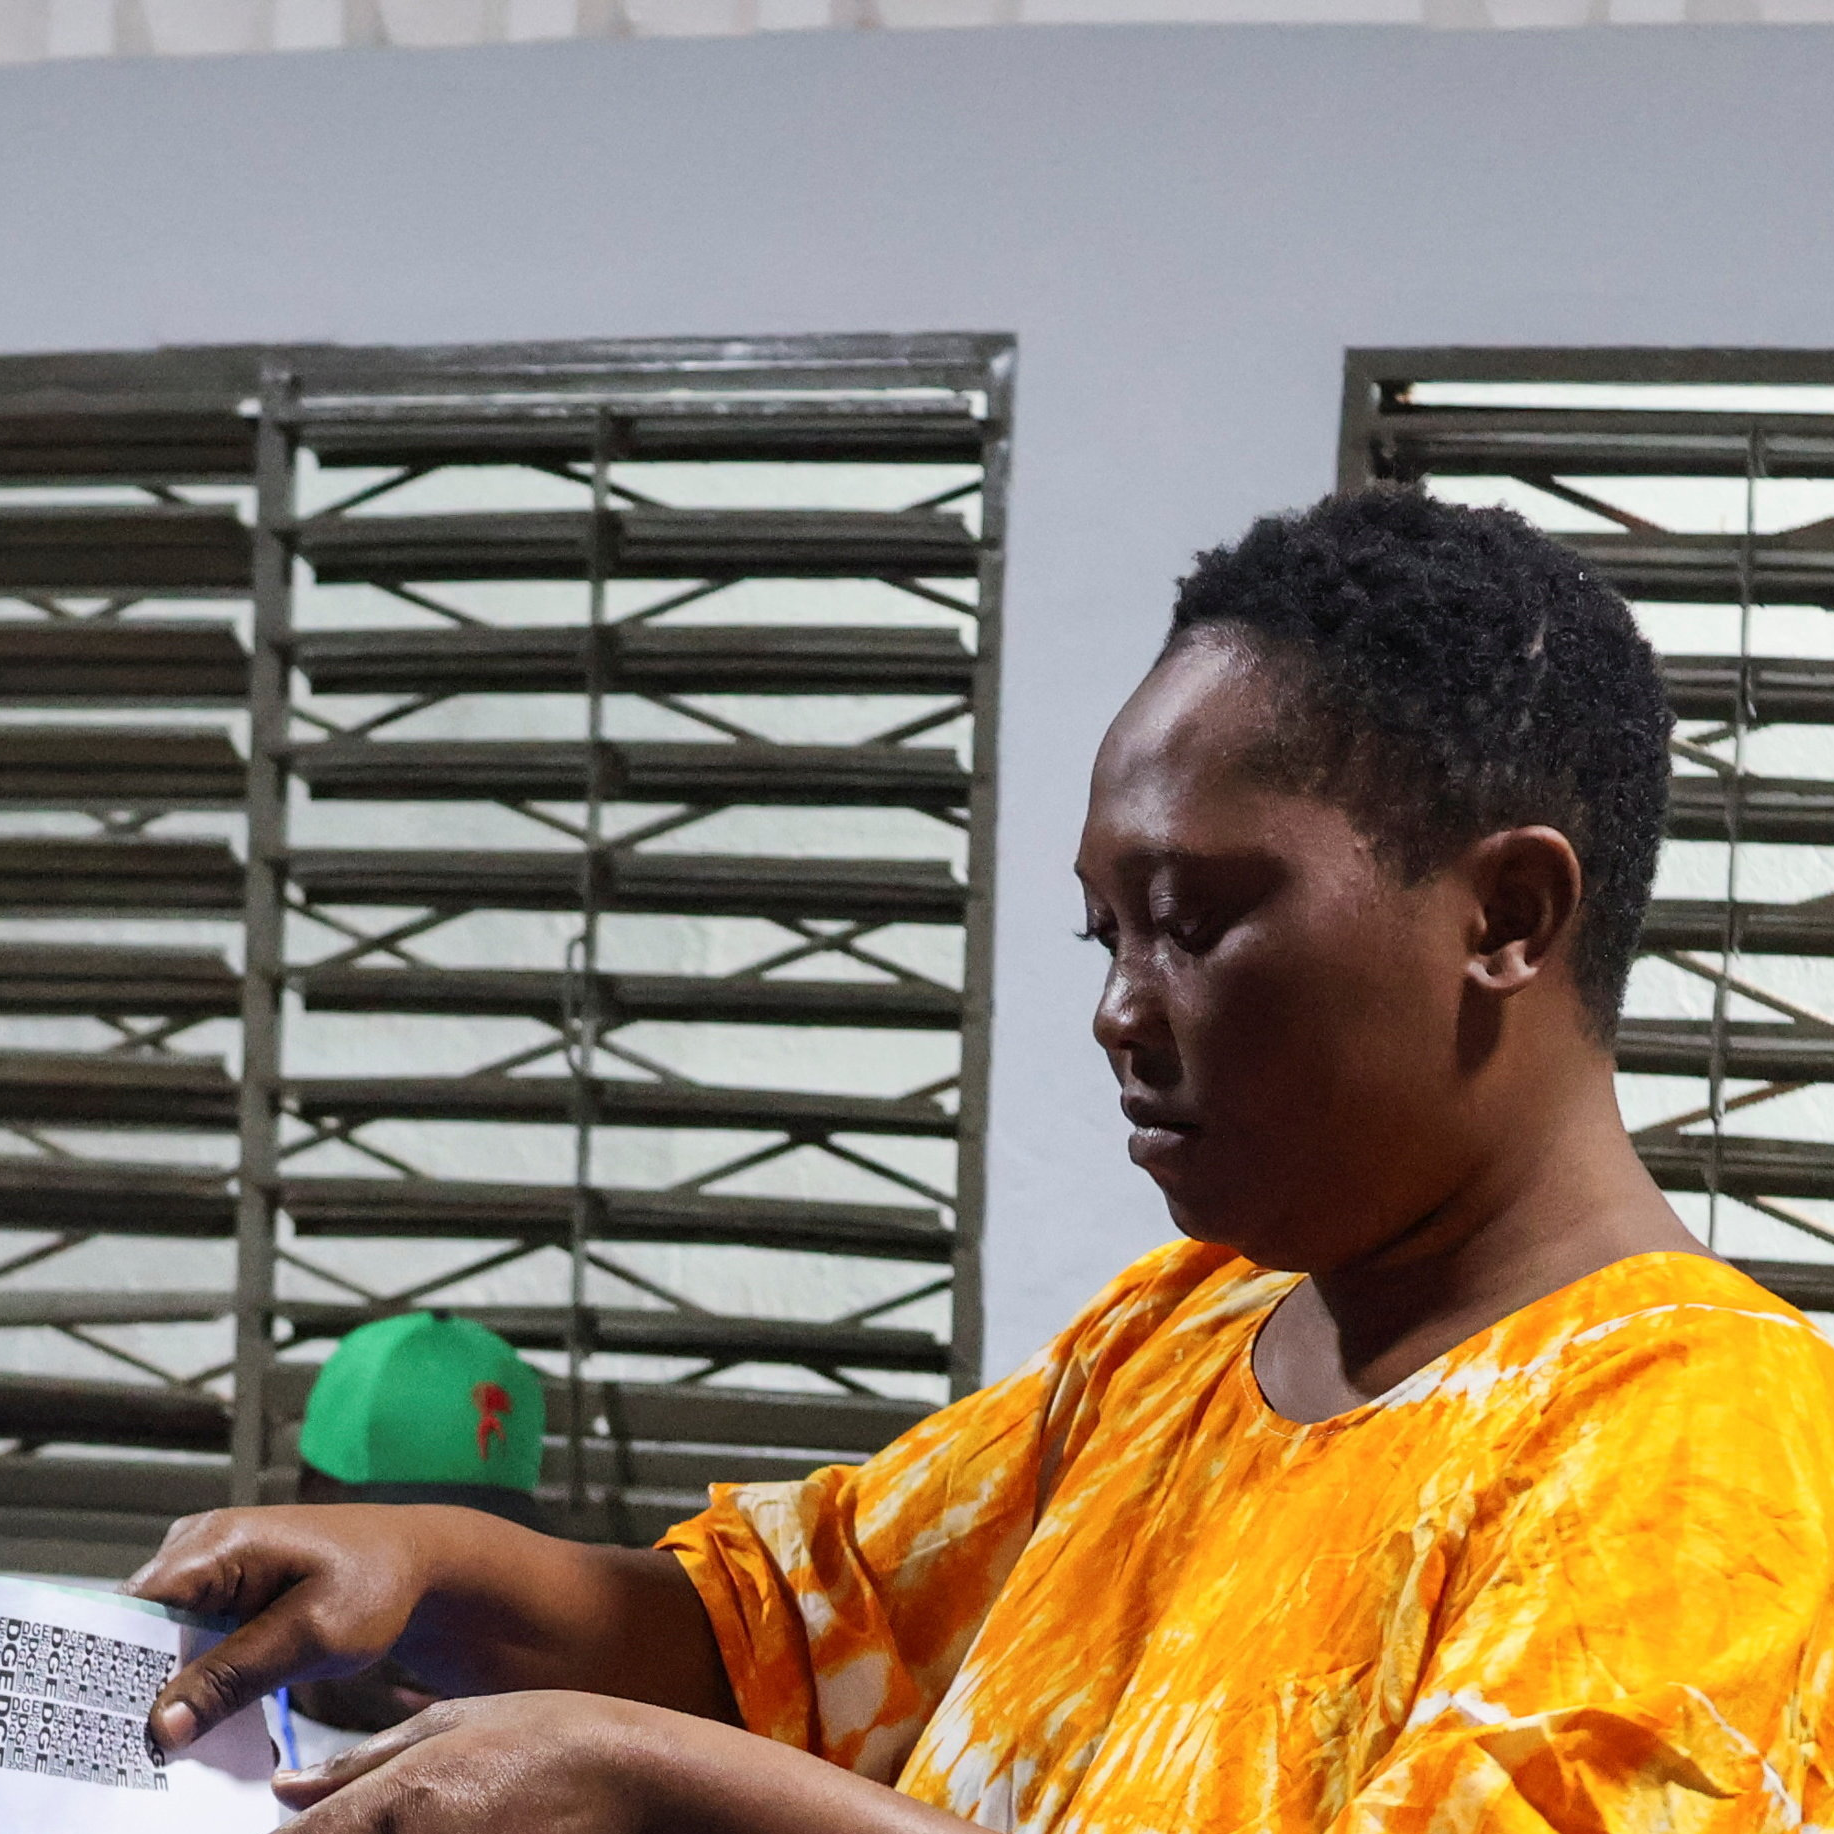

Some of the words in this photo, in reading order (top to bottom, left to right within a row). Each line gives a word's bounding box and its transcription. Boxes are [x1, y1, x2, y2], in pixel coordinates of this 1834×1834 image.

[22, 1621, 51, 1639] DGE
[44, 1626, 64, 1698] DGE
[12, 1697, 41, 1714] DGE
[34, 1702, 54, 1774] DGE
